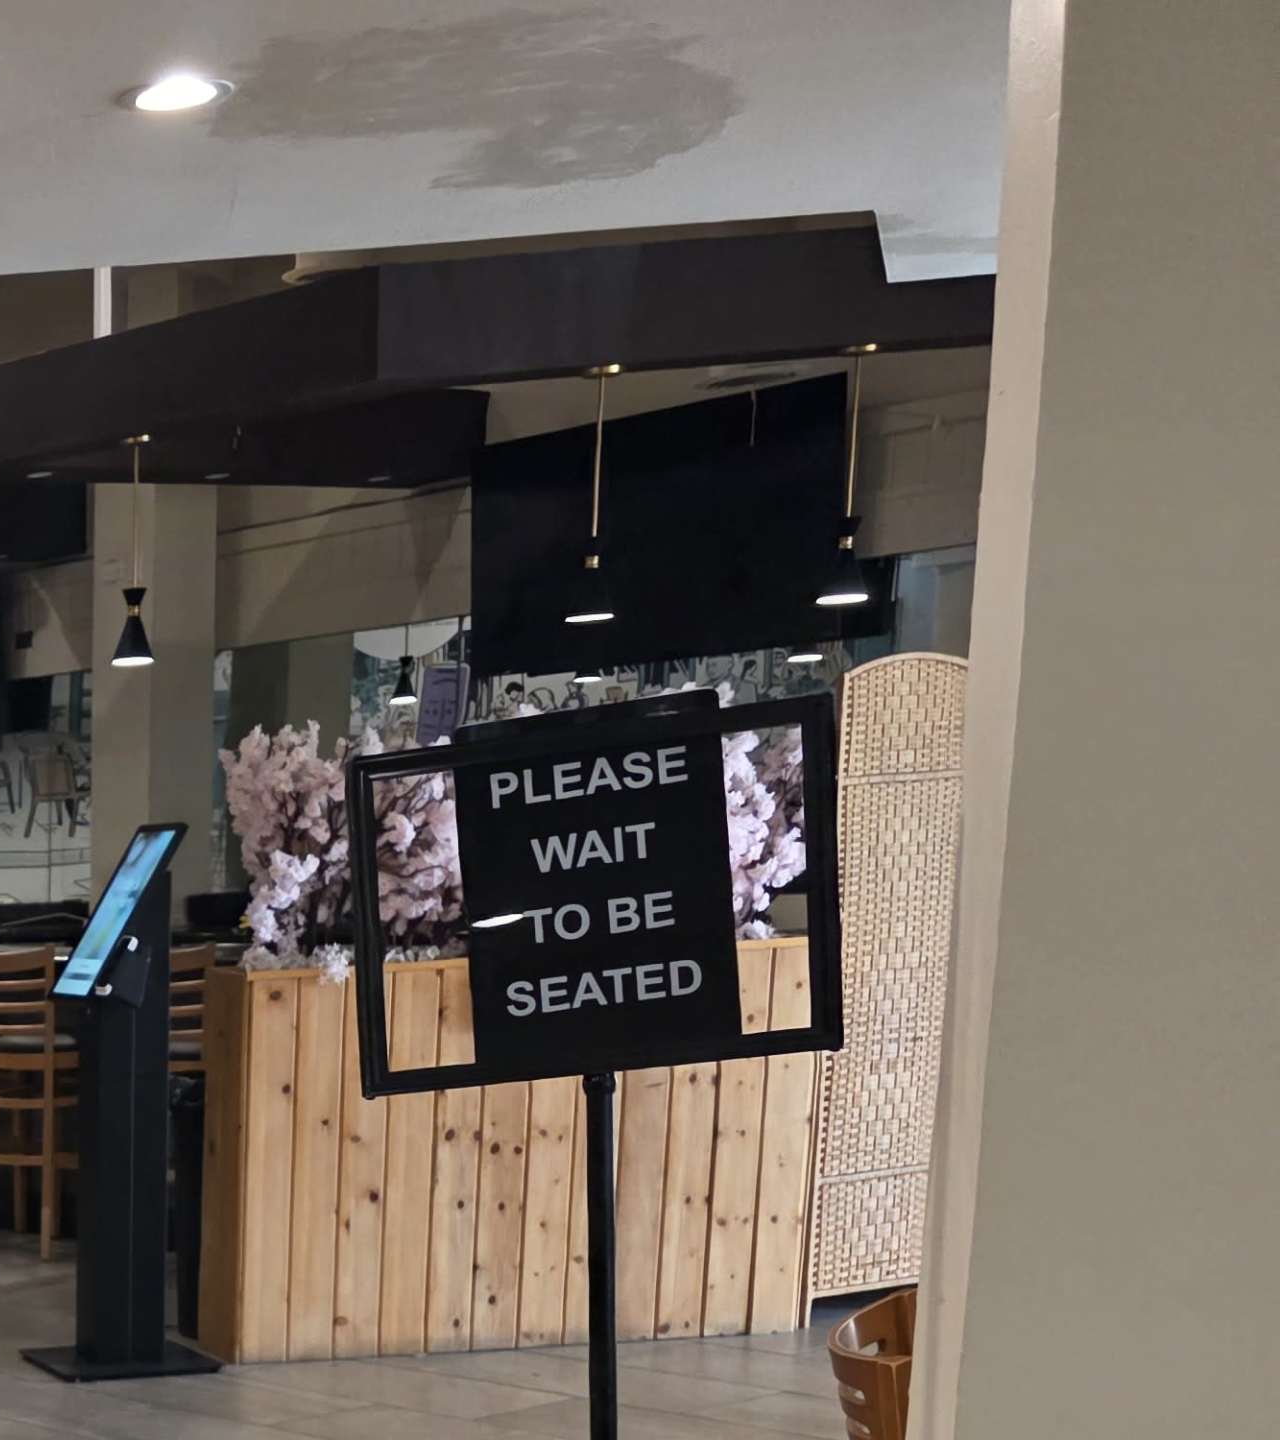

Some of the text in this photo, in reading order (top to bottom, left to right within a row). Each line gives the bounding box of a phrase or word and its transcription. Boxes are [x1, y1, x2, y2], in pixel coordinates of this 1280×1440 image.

[490, 746, 688, 809] PLEASE
[530, 822, 655, 873] WAIT
[524, 891, 675, 943] TO BE
[506, 959, 702, 1017] SEATED
